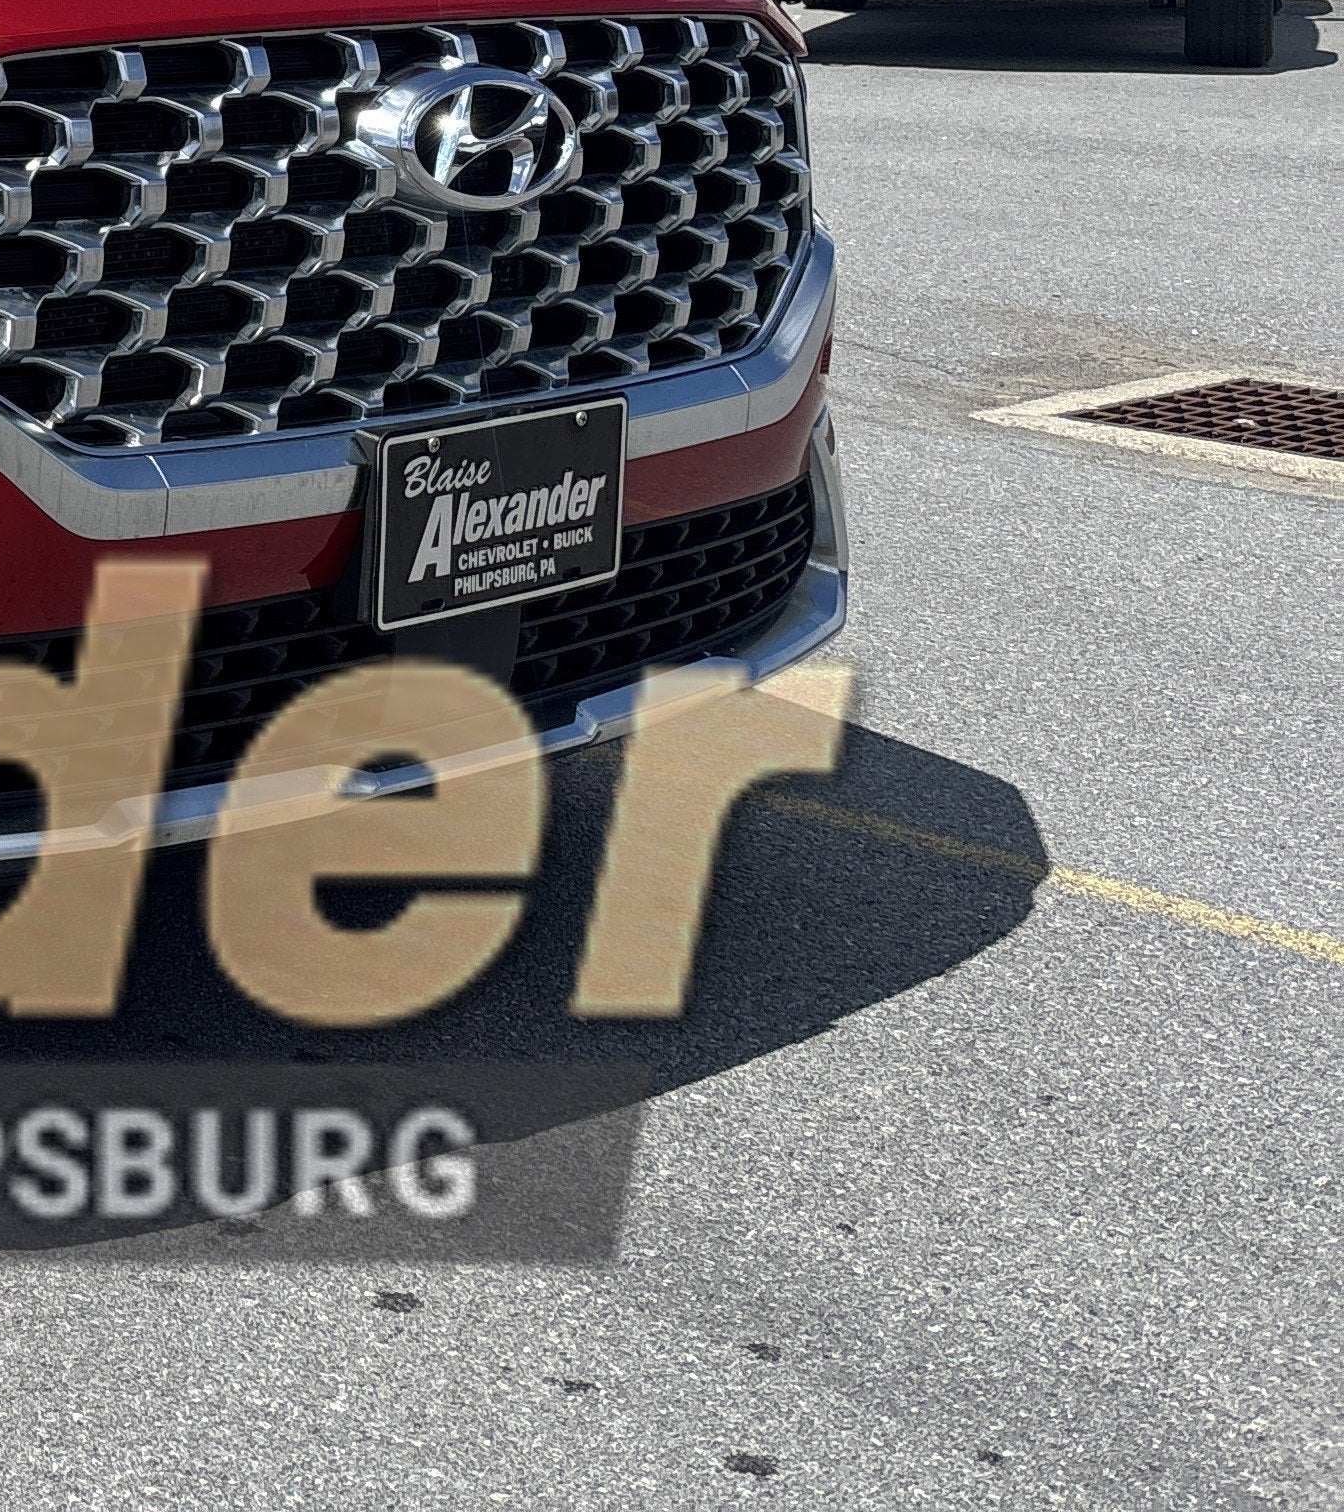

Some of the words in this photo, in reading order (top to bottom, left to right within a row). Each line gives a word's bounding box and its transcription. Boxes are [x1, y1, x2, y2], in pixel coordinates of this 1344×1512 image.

[403, 455, 492, 499] Blaise
[408, 470, 607, 583] Alexander
[458, 538, 538, 571] CHEVROLET
[553, 525, 594, 550] BUICK
[454, 564, 538, 597] PHILIPSBURG,
[540, 557, 556, 576] PA
